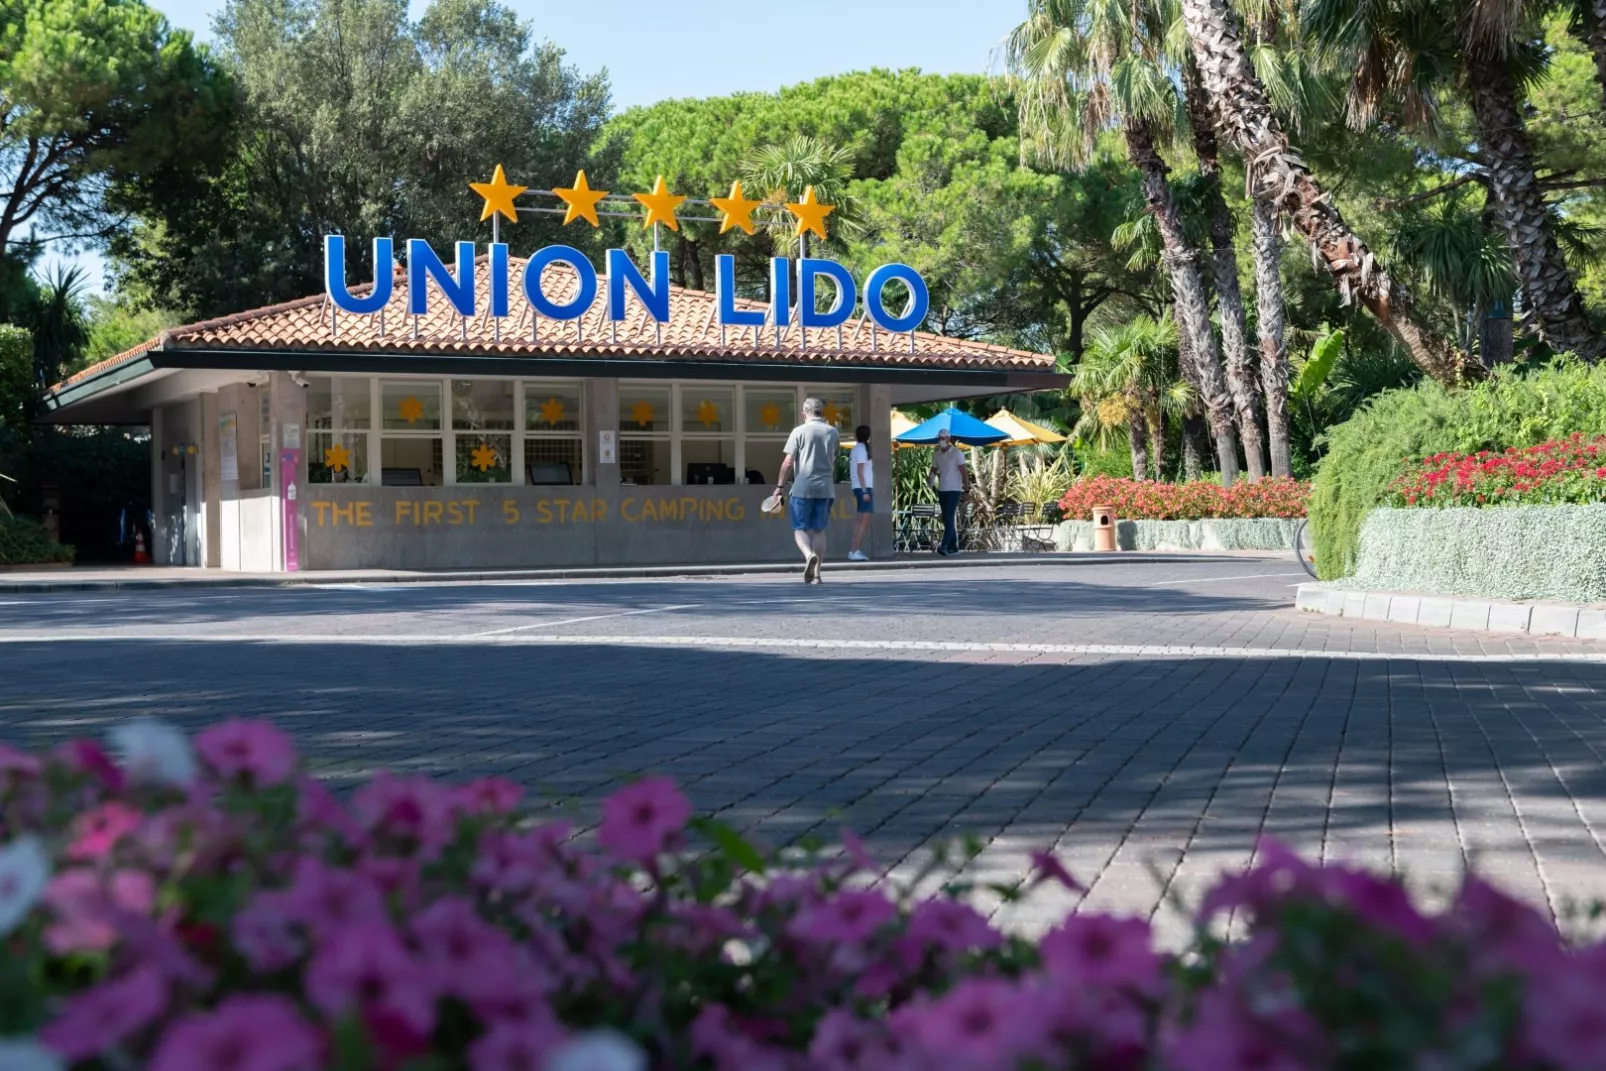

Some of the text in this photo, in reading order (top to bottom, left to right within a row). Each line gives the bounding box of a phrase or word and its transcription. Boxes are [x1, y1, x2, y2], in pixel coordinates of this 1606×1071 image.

[324, 234, 929, 333] UNION LIDO
[311, 500, 373, 527] THE
[395, 500, 480, 526] FIRST
[502, 500, 521, 524] 5
[536, 498, 607, 524] STAR
[620, 496, 745, 523] CAMPING
